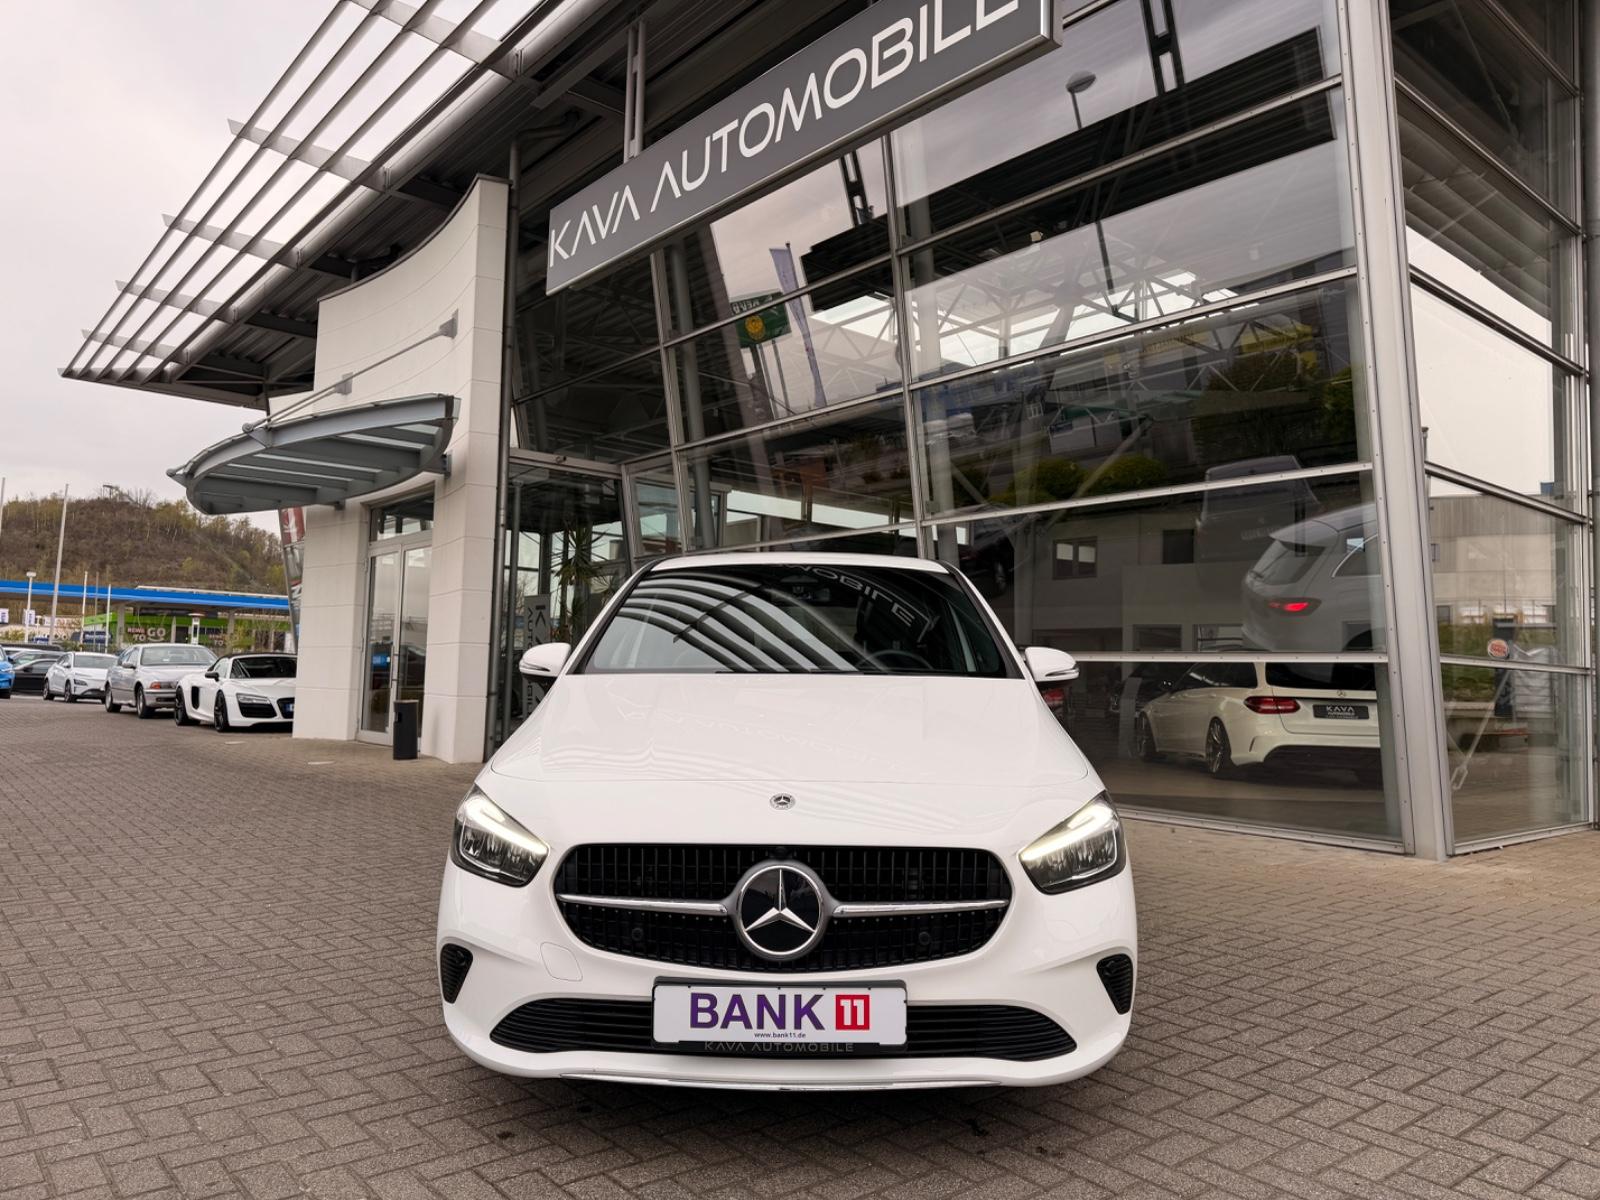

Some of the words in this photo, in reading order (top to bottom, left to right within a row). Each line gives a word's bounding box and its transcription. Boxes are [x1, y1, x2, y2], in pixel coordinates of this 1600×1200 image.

[548, 184, 640, 267] KAVA
[147, 627, 166, 637] GO
[690, 992, 825, 1031] BANK
[838, 997, 868, 1028] 11
[704, 1042, 745, 1052] KAVA
[751, 1042, 854, 1053] AUTOMOBILE
